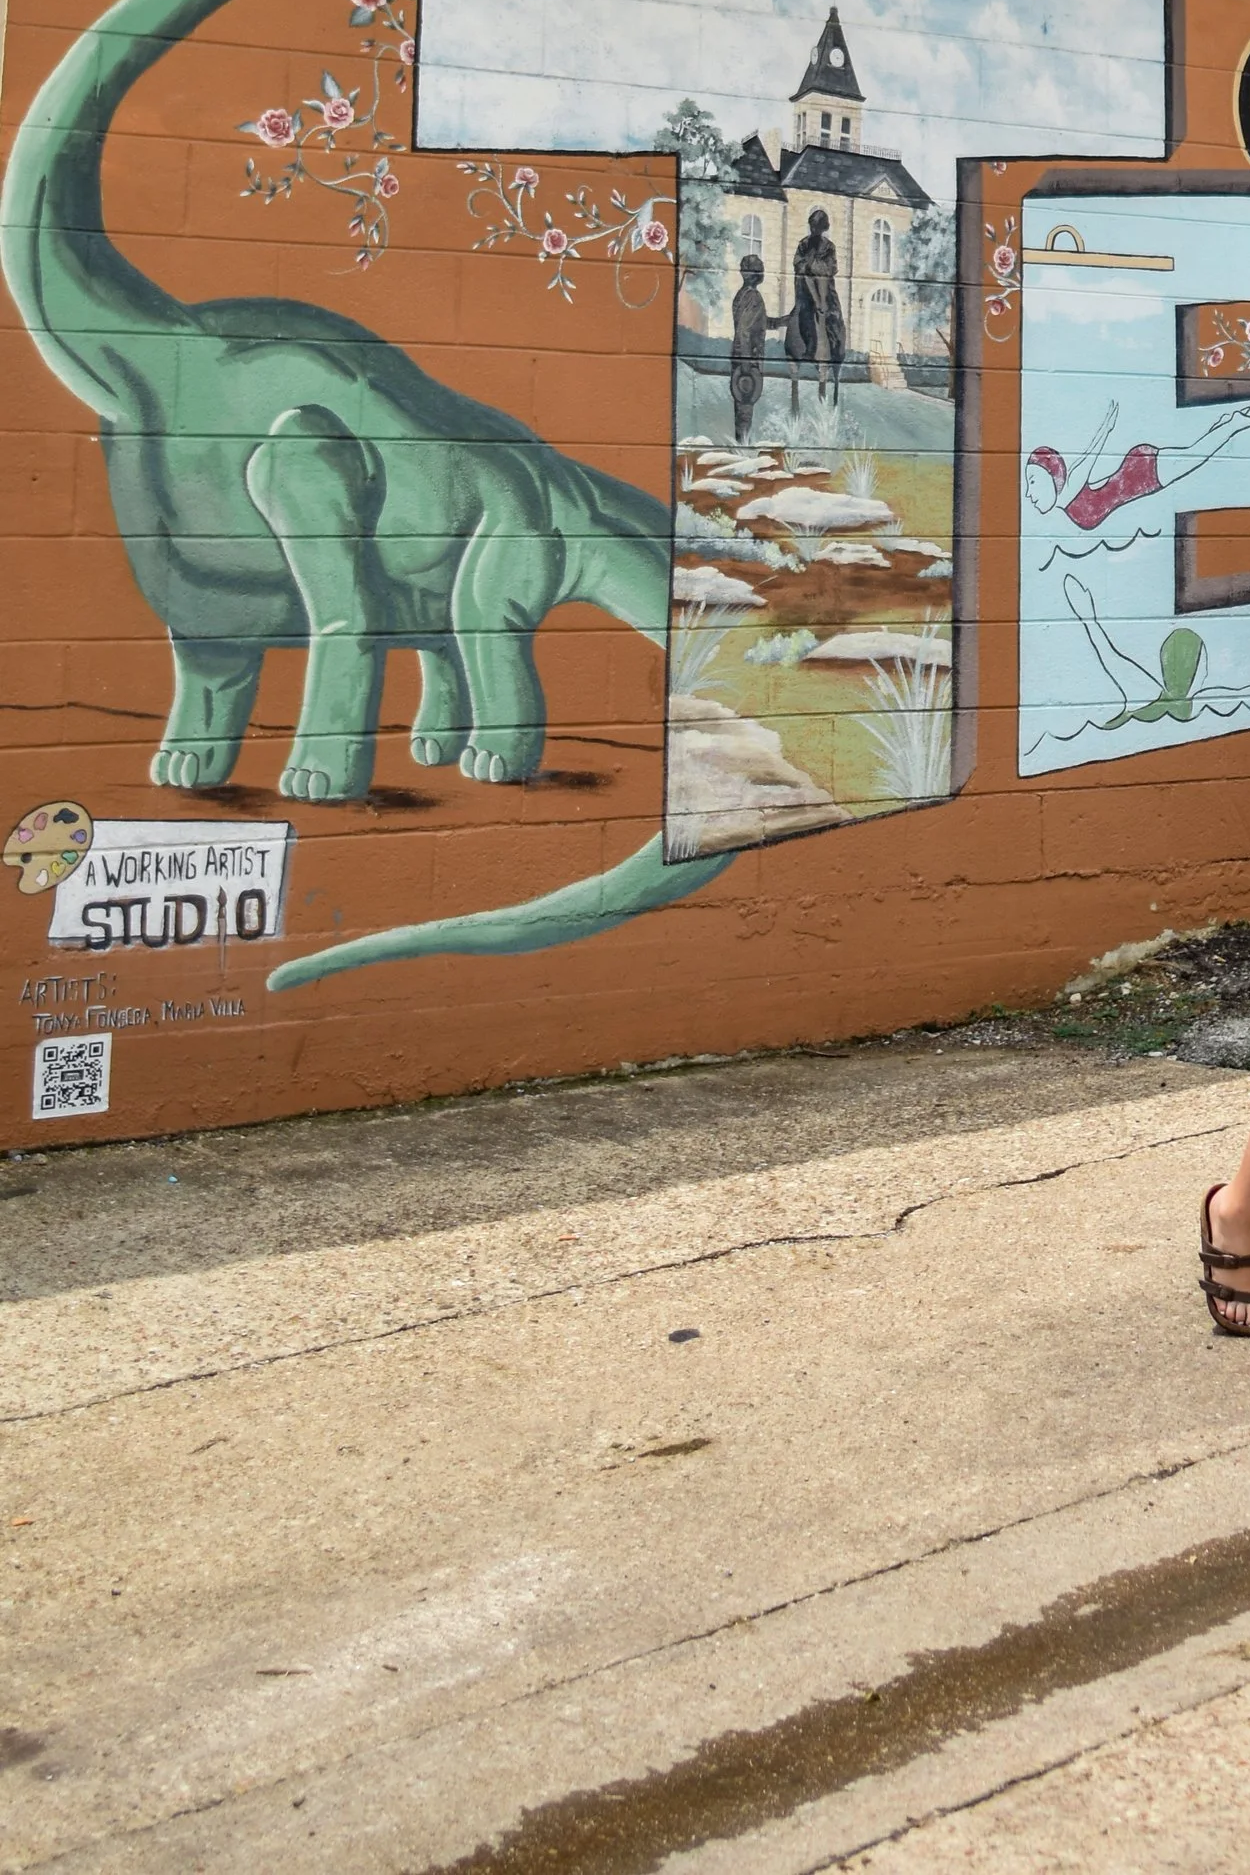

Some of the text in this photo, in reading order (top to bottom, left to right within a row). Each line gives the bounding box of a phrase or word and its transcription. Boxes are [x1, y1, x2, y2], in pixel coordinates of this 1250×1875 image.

[85, 845, 271, 888] A WORKING ARTIST
[82, 885, 267, 976] STUDIO
[19, 971, 117, 1009] ARTISTS:
